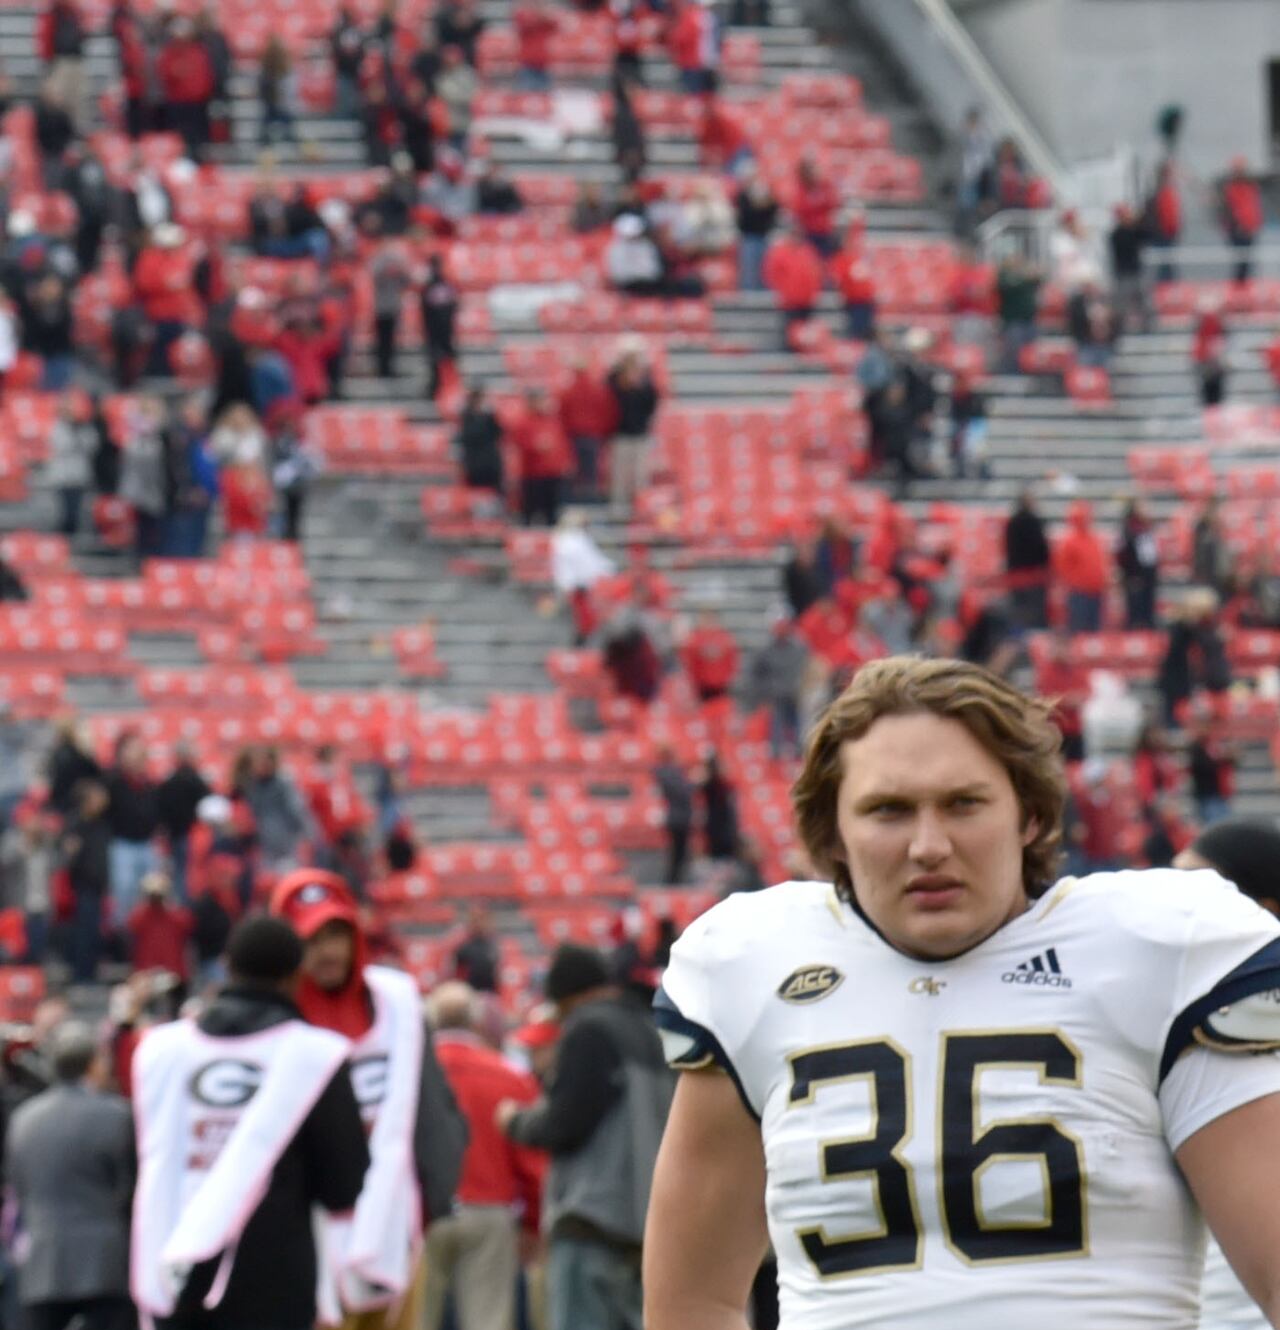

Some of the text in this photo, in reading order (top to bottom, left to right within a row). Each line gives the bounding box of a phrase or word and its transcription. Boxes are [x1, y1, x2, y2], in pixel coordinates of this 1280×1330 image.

[788, 971, 834, 997] ACC
[1001, 971, 1072, 988] adidas
[787, 1029, 1090, 1279] 36
